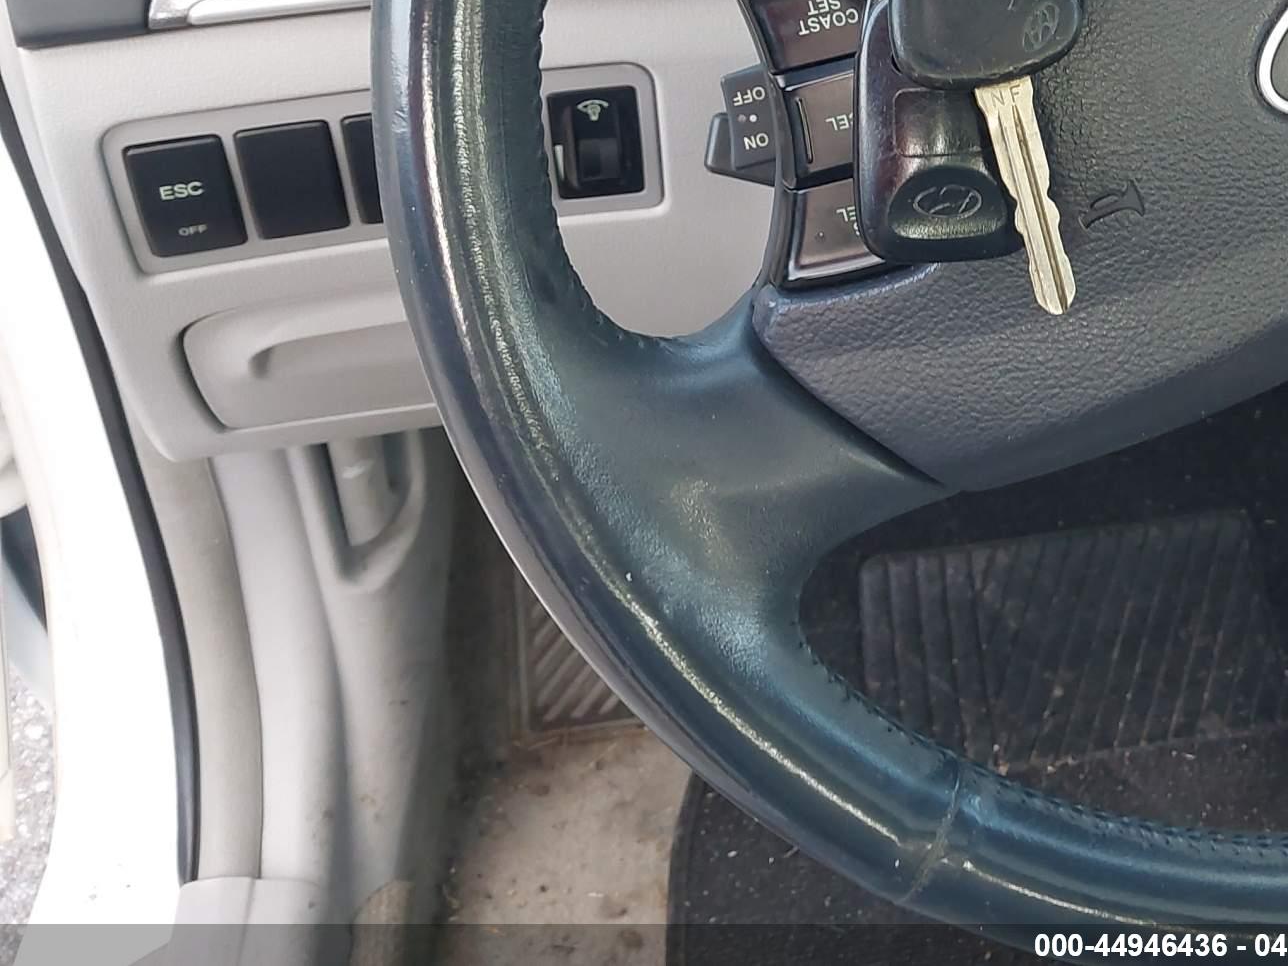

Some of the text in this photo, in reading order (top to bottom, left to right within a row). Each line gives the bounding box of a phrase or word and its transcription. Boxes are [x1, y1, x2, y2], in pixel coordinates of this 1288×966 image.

[798, 8, 859, 36] COAST
[732, 86, 766, 107] OFF
[743, 132, 769, 151] ON
[159, 181, 204, 201] ESC
[178, 223, 208, 236] OFF
